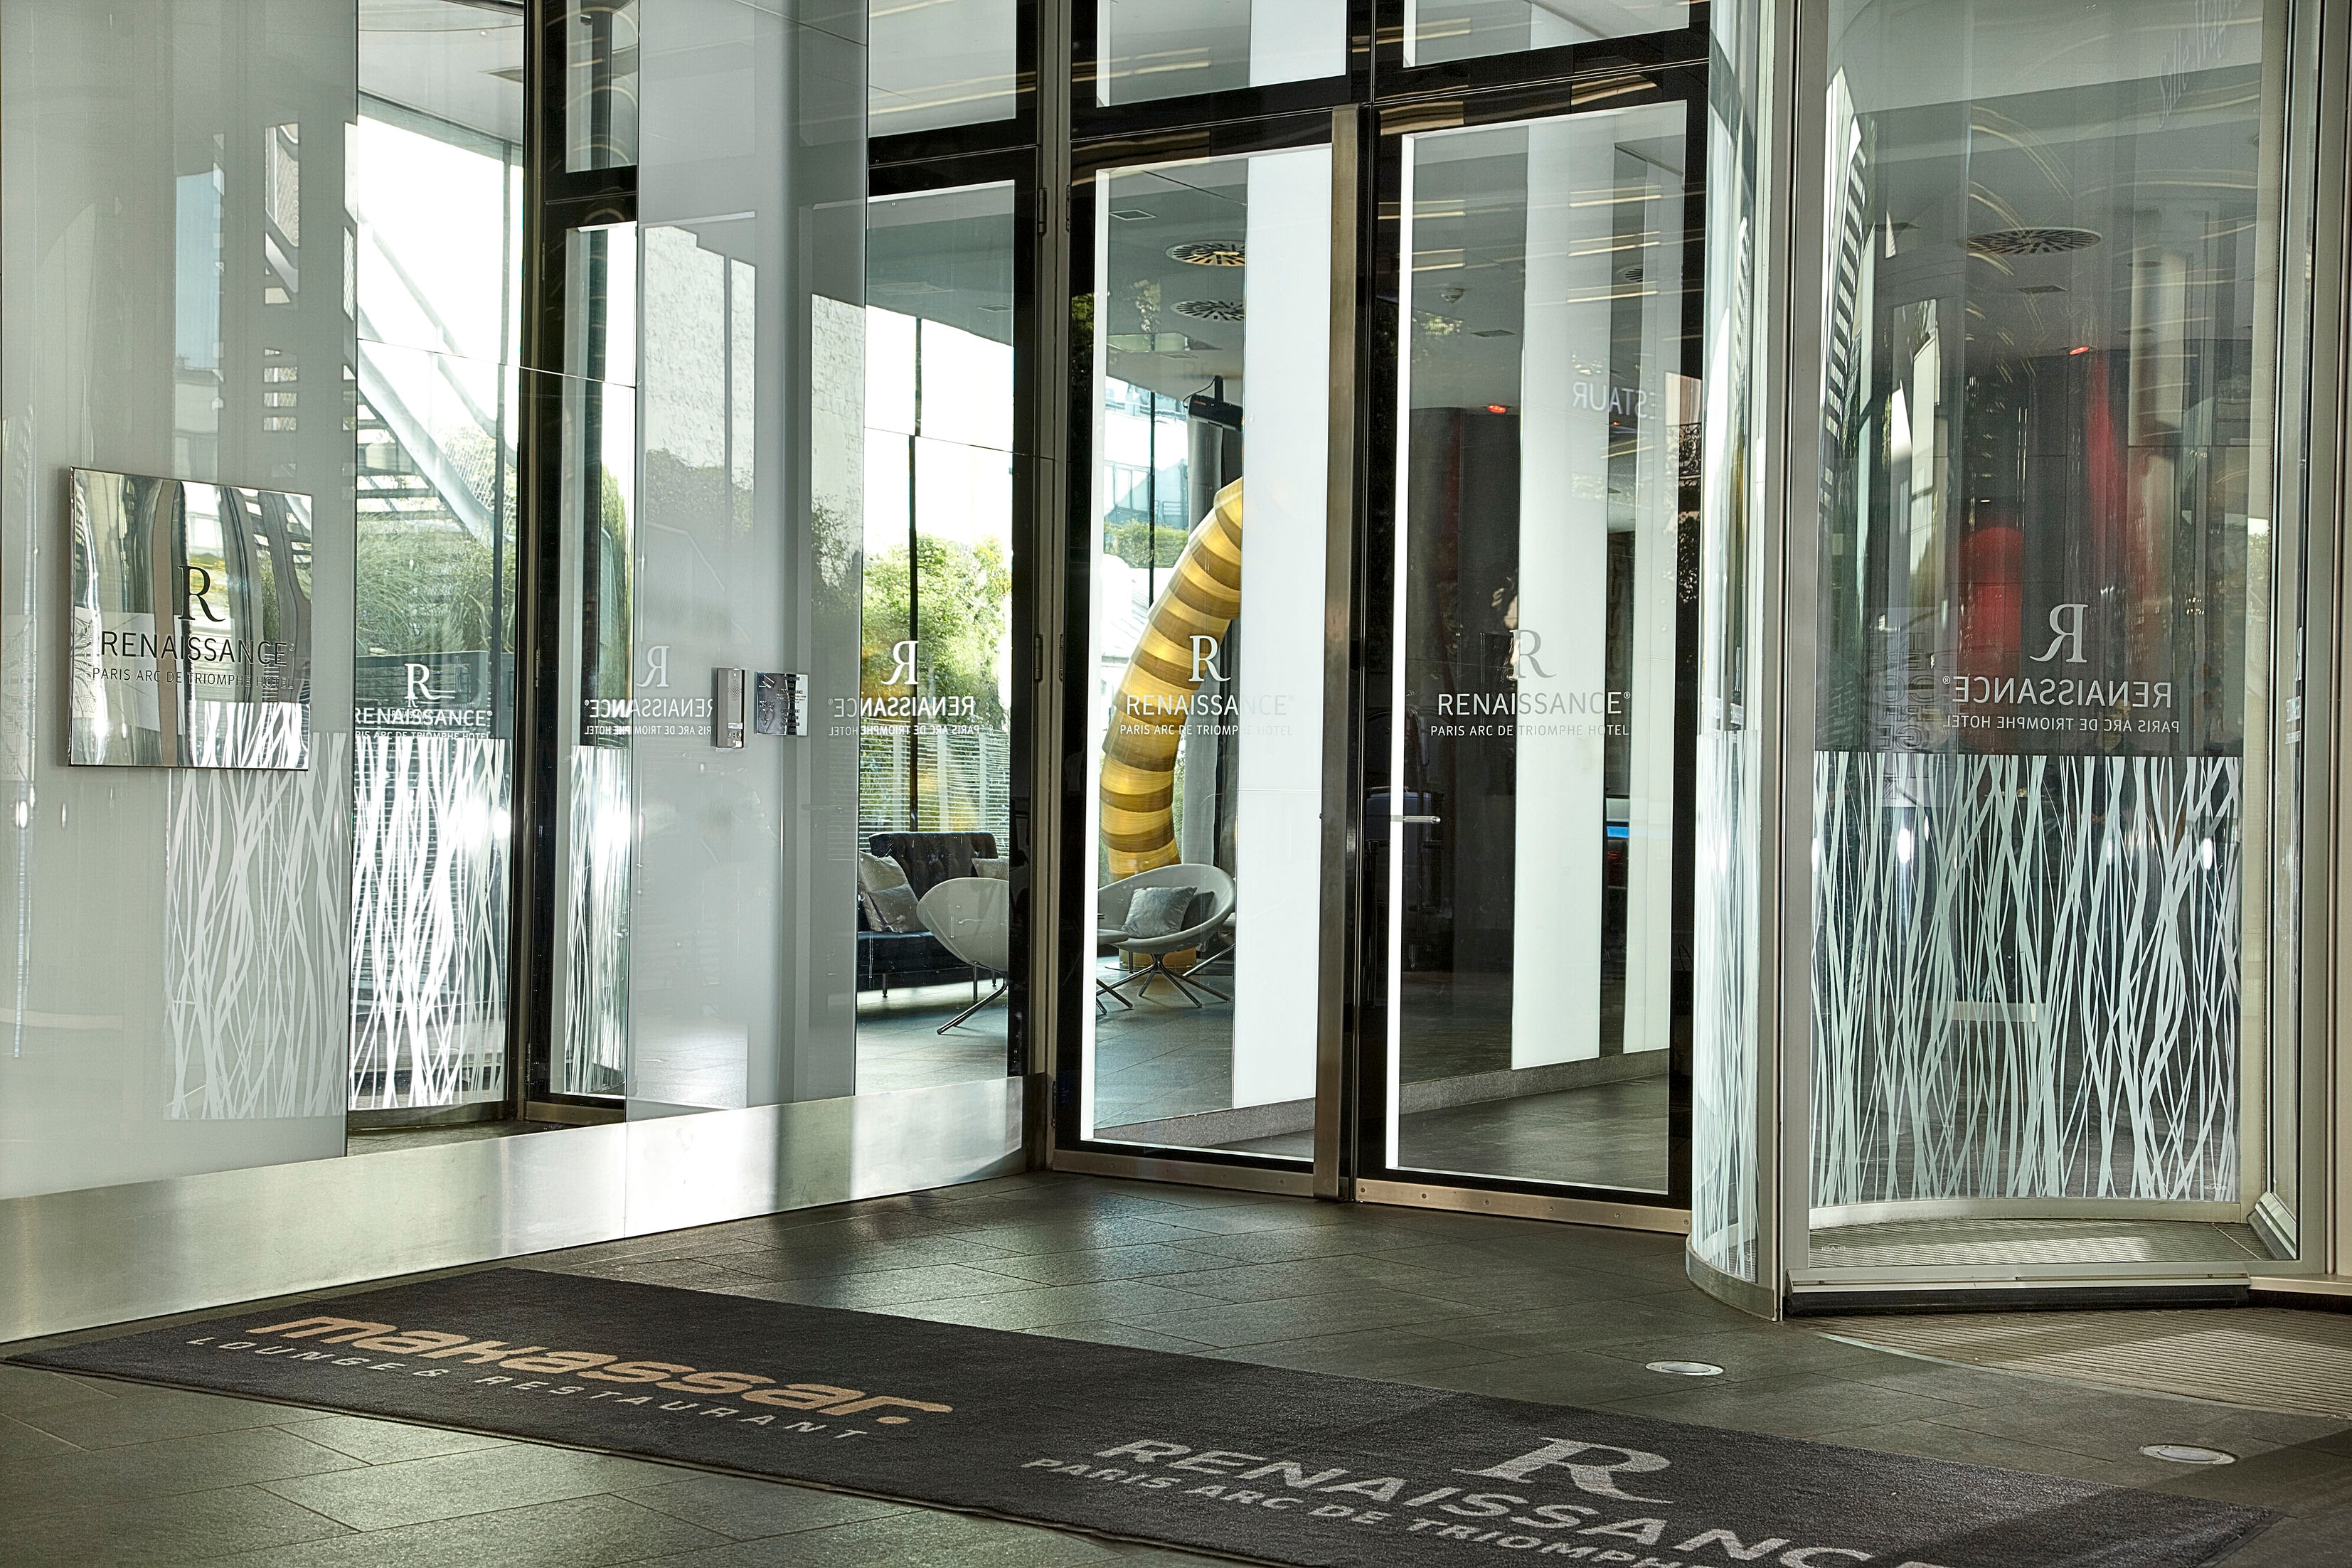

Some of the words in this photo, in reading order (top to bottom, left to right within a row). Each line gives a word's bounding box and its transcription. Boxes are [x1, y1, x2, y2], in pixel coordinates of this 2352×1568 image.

[178, 565, 226, 622] R
[1188, 635, 1231, 682] R
[1509, 629, 1558, 678] R
[92, 668, 131, 681] PARIS
[136, 670, 161, 683] ARC
[166, 671, 182, 683] DE
[187, 672, 251, 688] TRIOMPHE
[256, 677, 294, 690] HOTEL
[404, 663, 442, 700] R
[1120, 725, 1150, 735] PARIS
[1154, 725, 1175, 735] ARC
[1178, 725, 1192, 735] DE
[1197, 725, 1252, 735] TRIOMPHE
[1257, 725, 1293, 736] HOTEL
[1430, 725, 1465, 736] PARIS
[1469, 725, 1493, 736] ARC
[1498, 725, 1513, 736] DE
[1518, 725, 1582, 736] TRIOMPHE
[1588, 725, 1629, 735] HOTEL
[186, 1337, 408, 1371] LOUNGE
[413, 1368, 449, 1378] &
[474, 1375, 868, 1439] RESTAURANT
[1021, 1458, 1182, 1488] PARIS
[1185, 1485, 1304, 1509] ARC
[1309, 1504, 1393, 1525] DE
[1451, 1436, 1674, 1504] R
[1095, 1439, 1937, 1568] RENAISSANC
